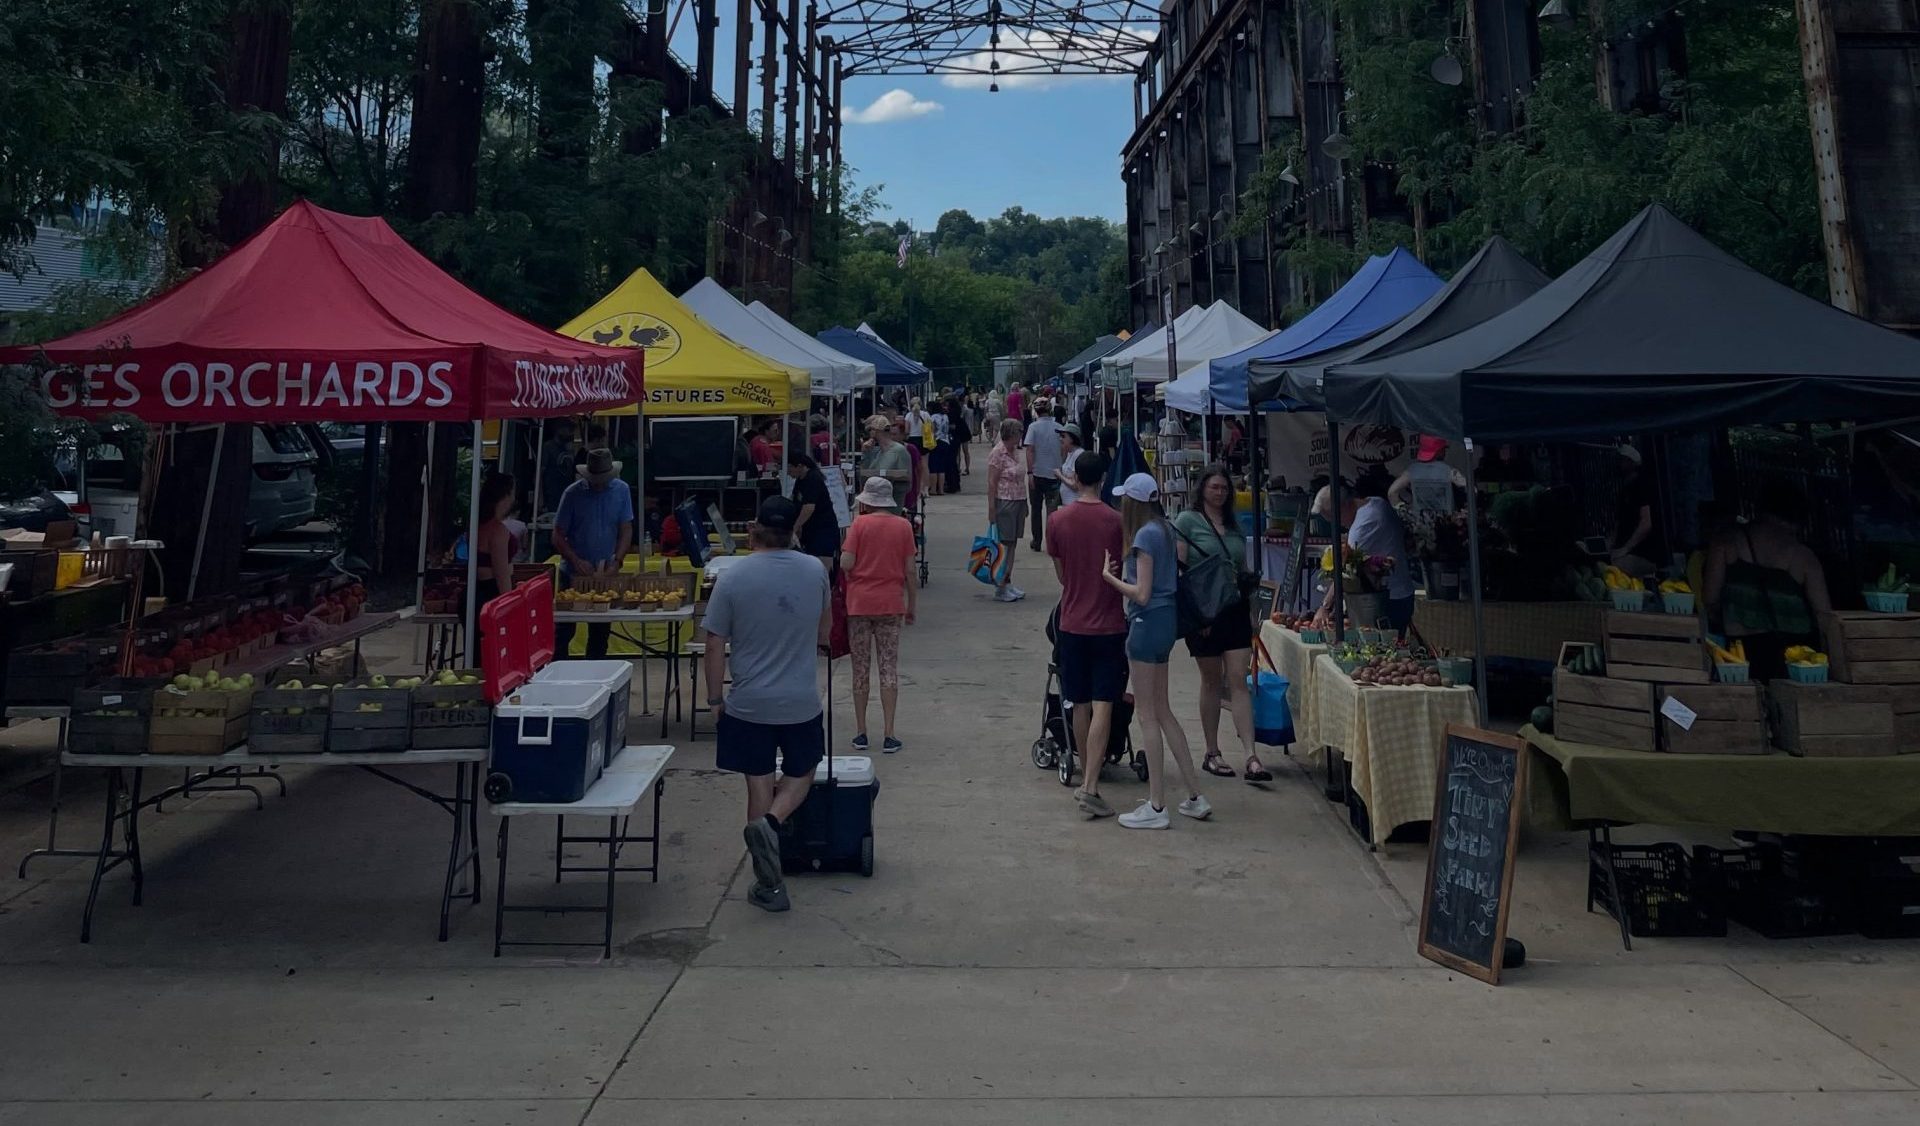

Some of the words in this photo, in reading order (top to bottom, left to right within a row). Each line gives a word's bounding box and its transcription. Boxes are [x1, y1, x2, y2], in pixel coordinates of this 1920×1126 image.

[42, 362, 142, 408] GES
[160, 361, 454, 408] ORCHARDS
[740, 379, 773, 399] LOCAL
[642, 389, 726, 403] ASTURES
[730, 386, 777, 409] CHICKEN
